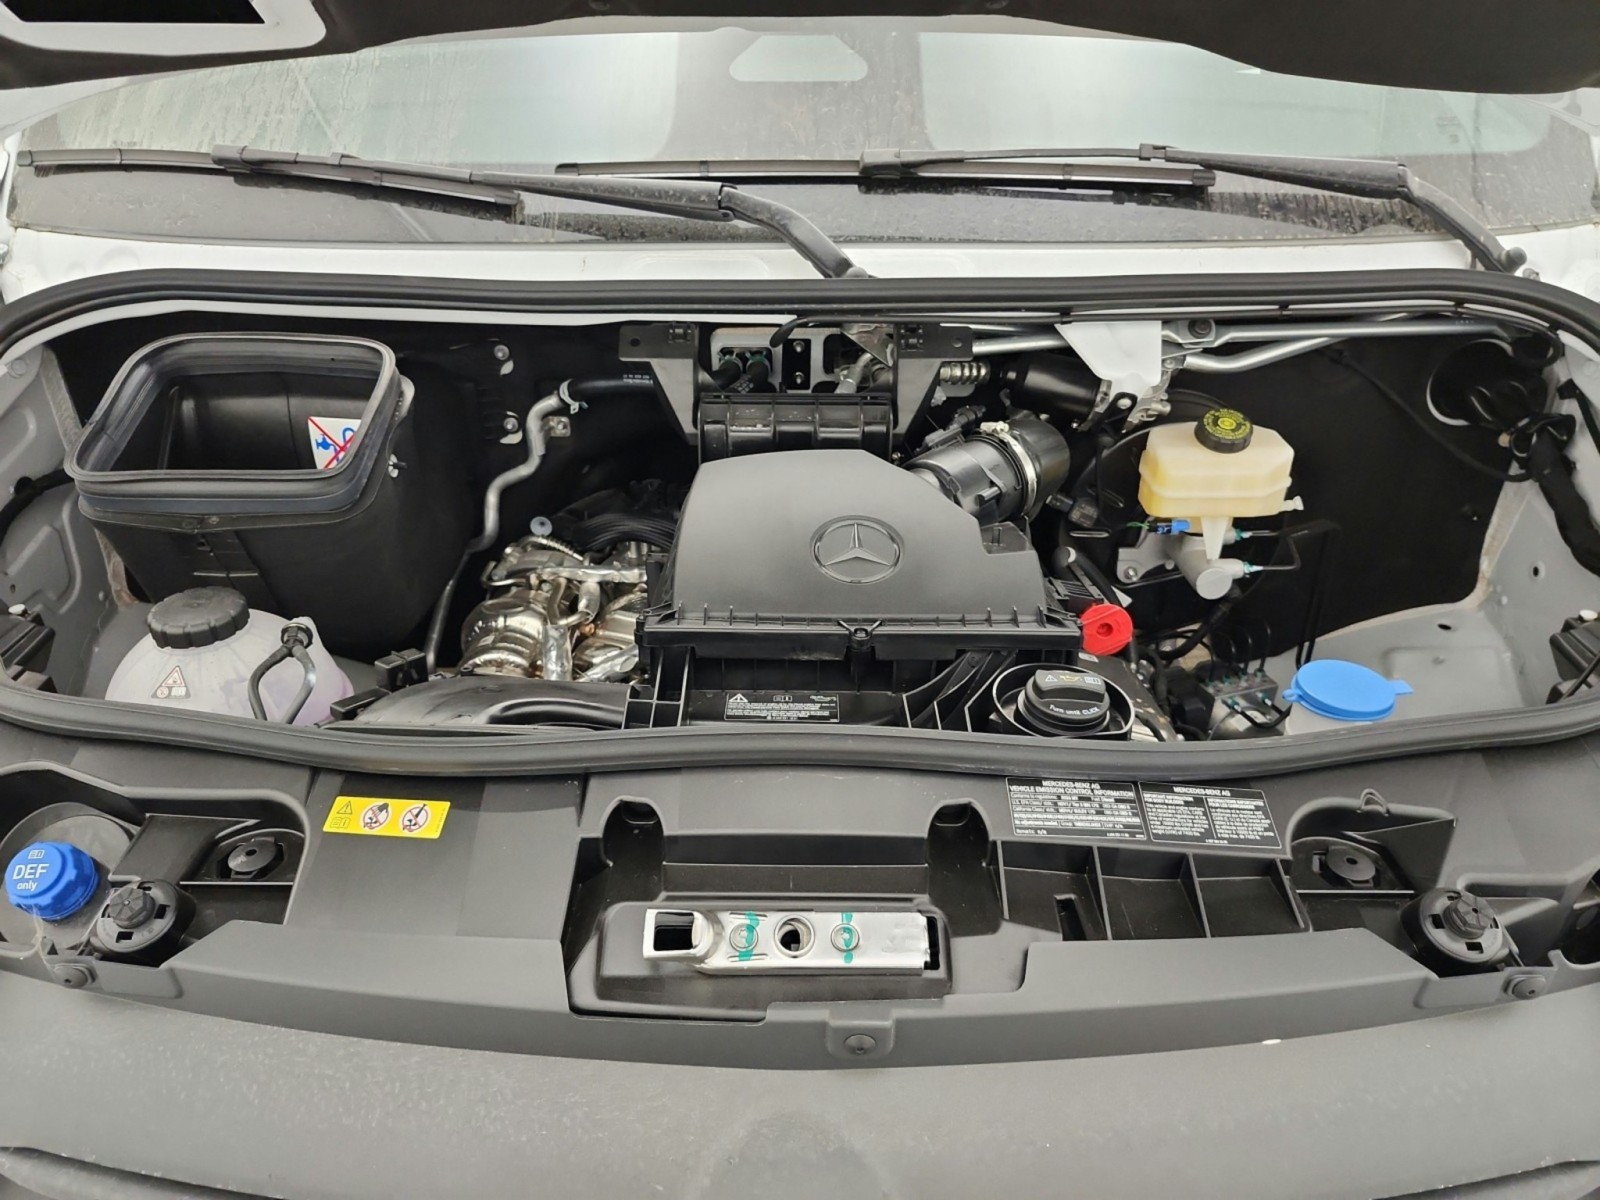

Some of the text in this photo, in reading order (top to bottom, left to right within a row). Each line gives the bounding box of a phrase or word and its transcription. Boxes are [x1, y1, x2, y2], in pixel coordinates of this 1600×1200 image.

[1049, 704, 1064, 713] Turn
[1082, 706, 1100, 716] CLICK
[1042, 780, 1090, 789] MERCEDES-BENZ
[1173, 786, 1222, 796] MERCEDES-BENZ
[12, 864, 50, 880] DEF
[16, 880, 38, 892] only
